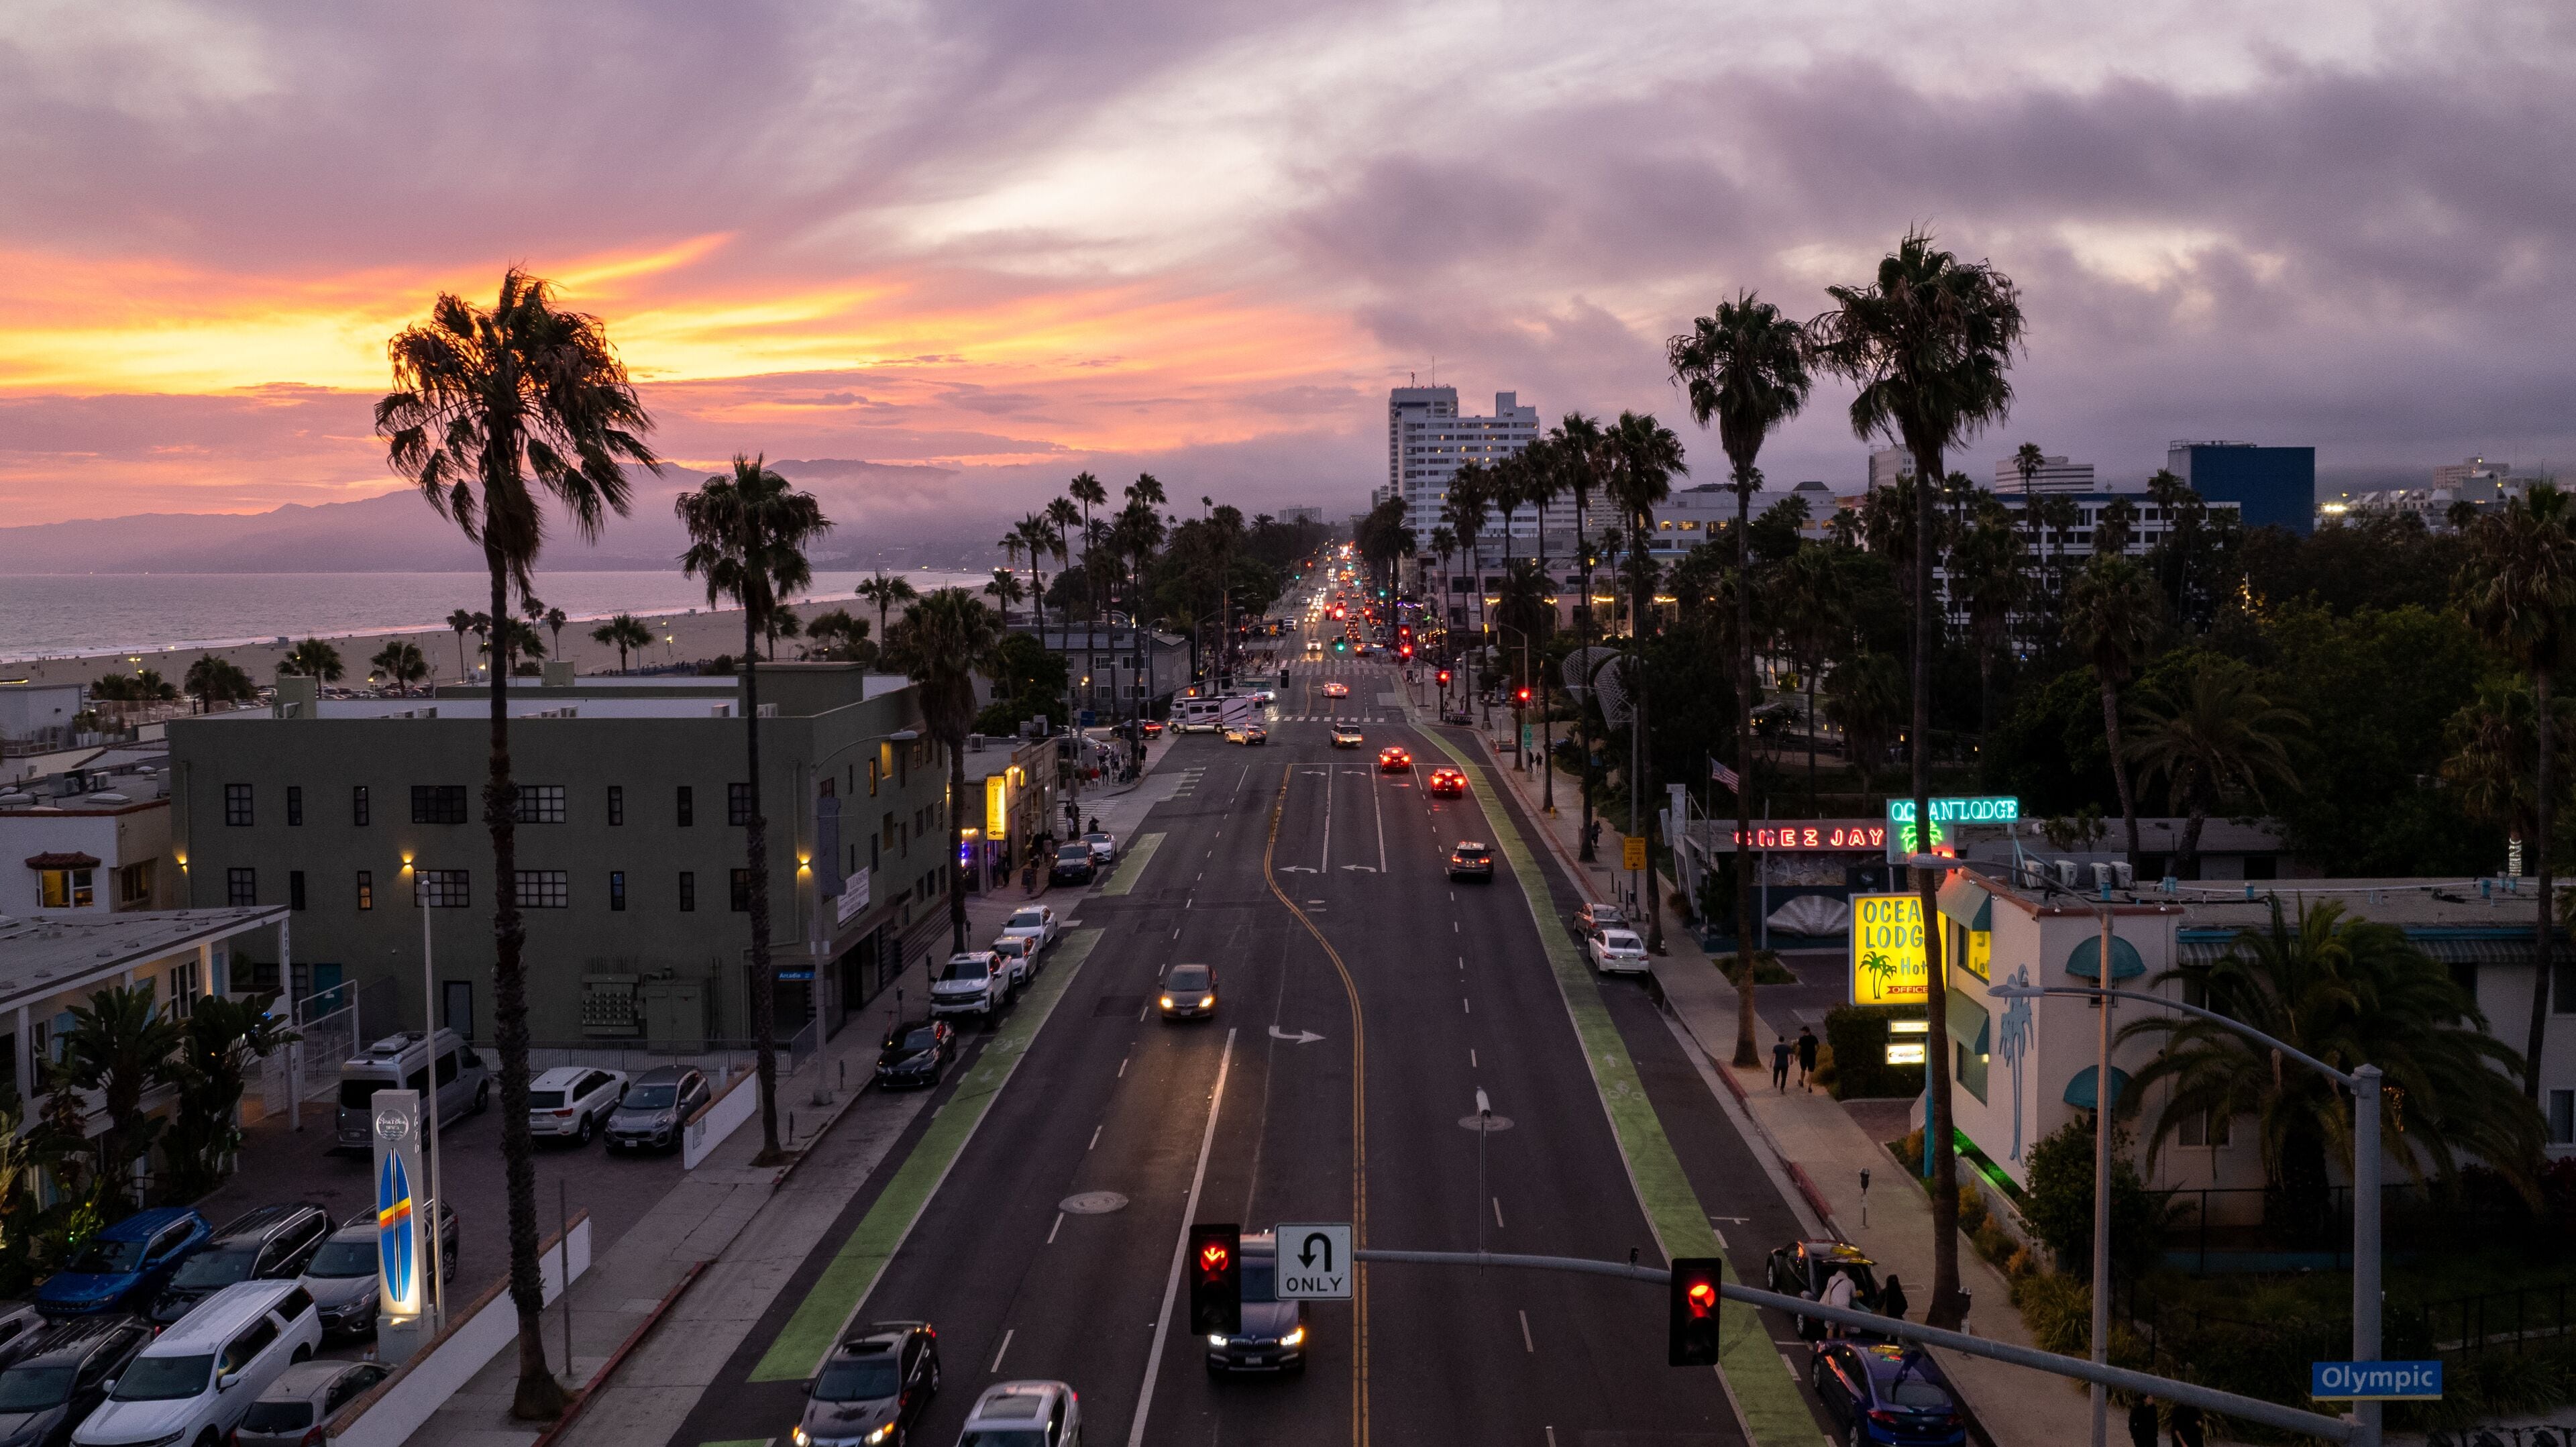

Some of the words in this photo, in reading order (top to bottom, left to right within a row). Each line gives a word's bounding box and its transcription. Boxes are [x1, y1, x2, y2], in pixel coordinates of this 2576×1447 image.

[1891, 802, 1953, 822] OCAN
[1958, 800, 2017, 820] LODGE
[1830, 828, 1884, 847] JAY
[1863, 900, 1922, 923] OCEA
[1866, 924, 1925, 949] LODG
[1900, 956, 1927, 975] Hot
[1286, 1277, 1343, 1292] ONLY
[2321, 1365, 2433, 1393] Olympic
